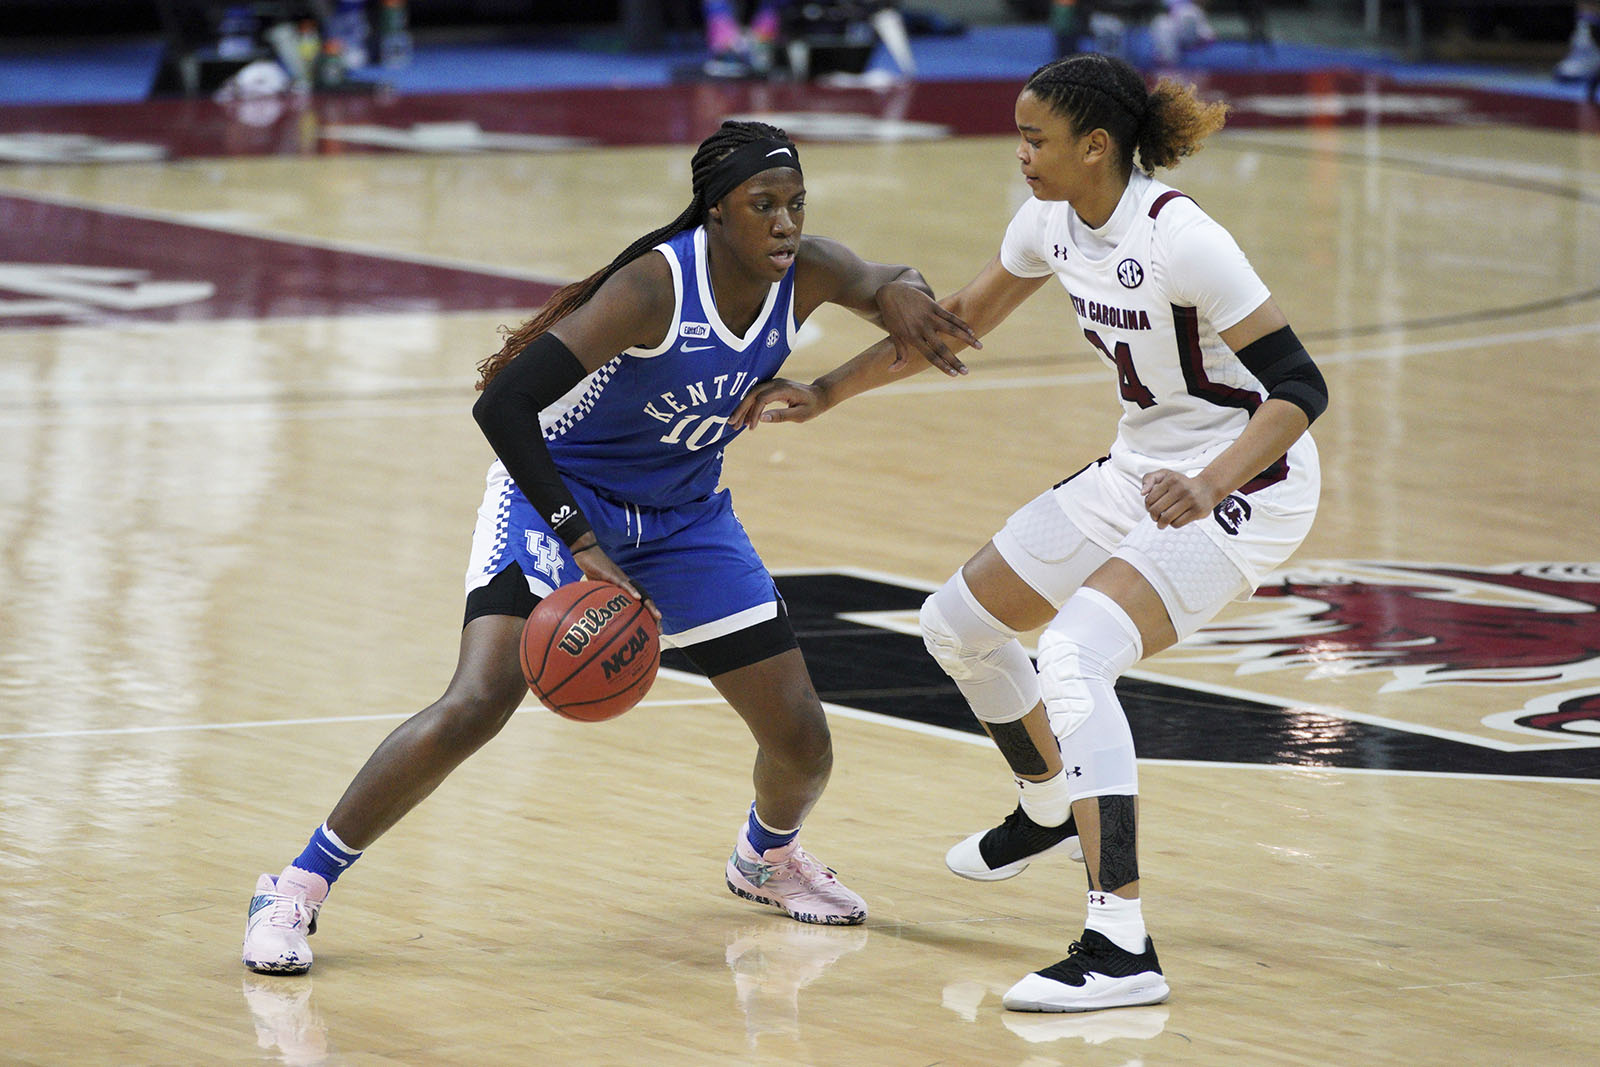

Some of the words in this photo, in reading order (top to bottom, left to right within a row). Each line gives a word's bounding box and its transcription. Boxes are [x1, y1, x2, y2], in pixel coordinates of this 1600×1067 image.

[1117, 259, 1144, 288] SEC
[1088, 300, 1152, 330] CAROLINA
[659, 414, 731, 451] 10
[524, 529, 565, 587] UK
[558, 593, 634, 657] Wilson
[601, 626, 650, 680] NCAA
